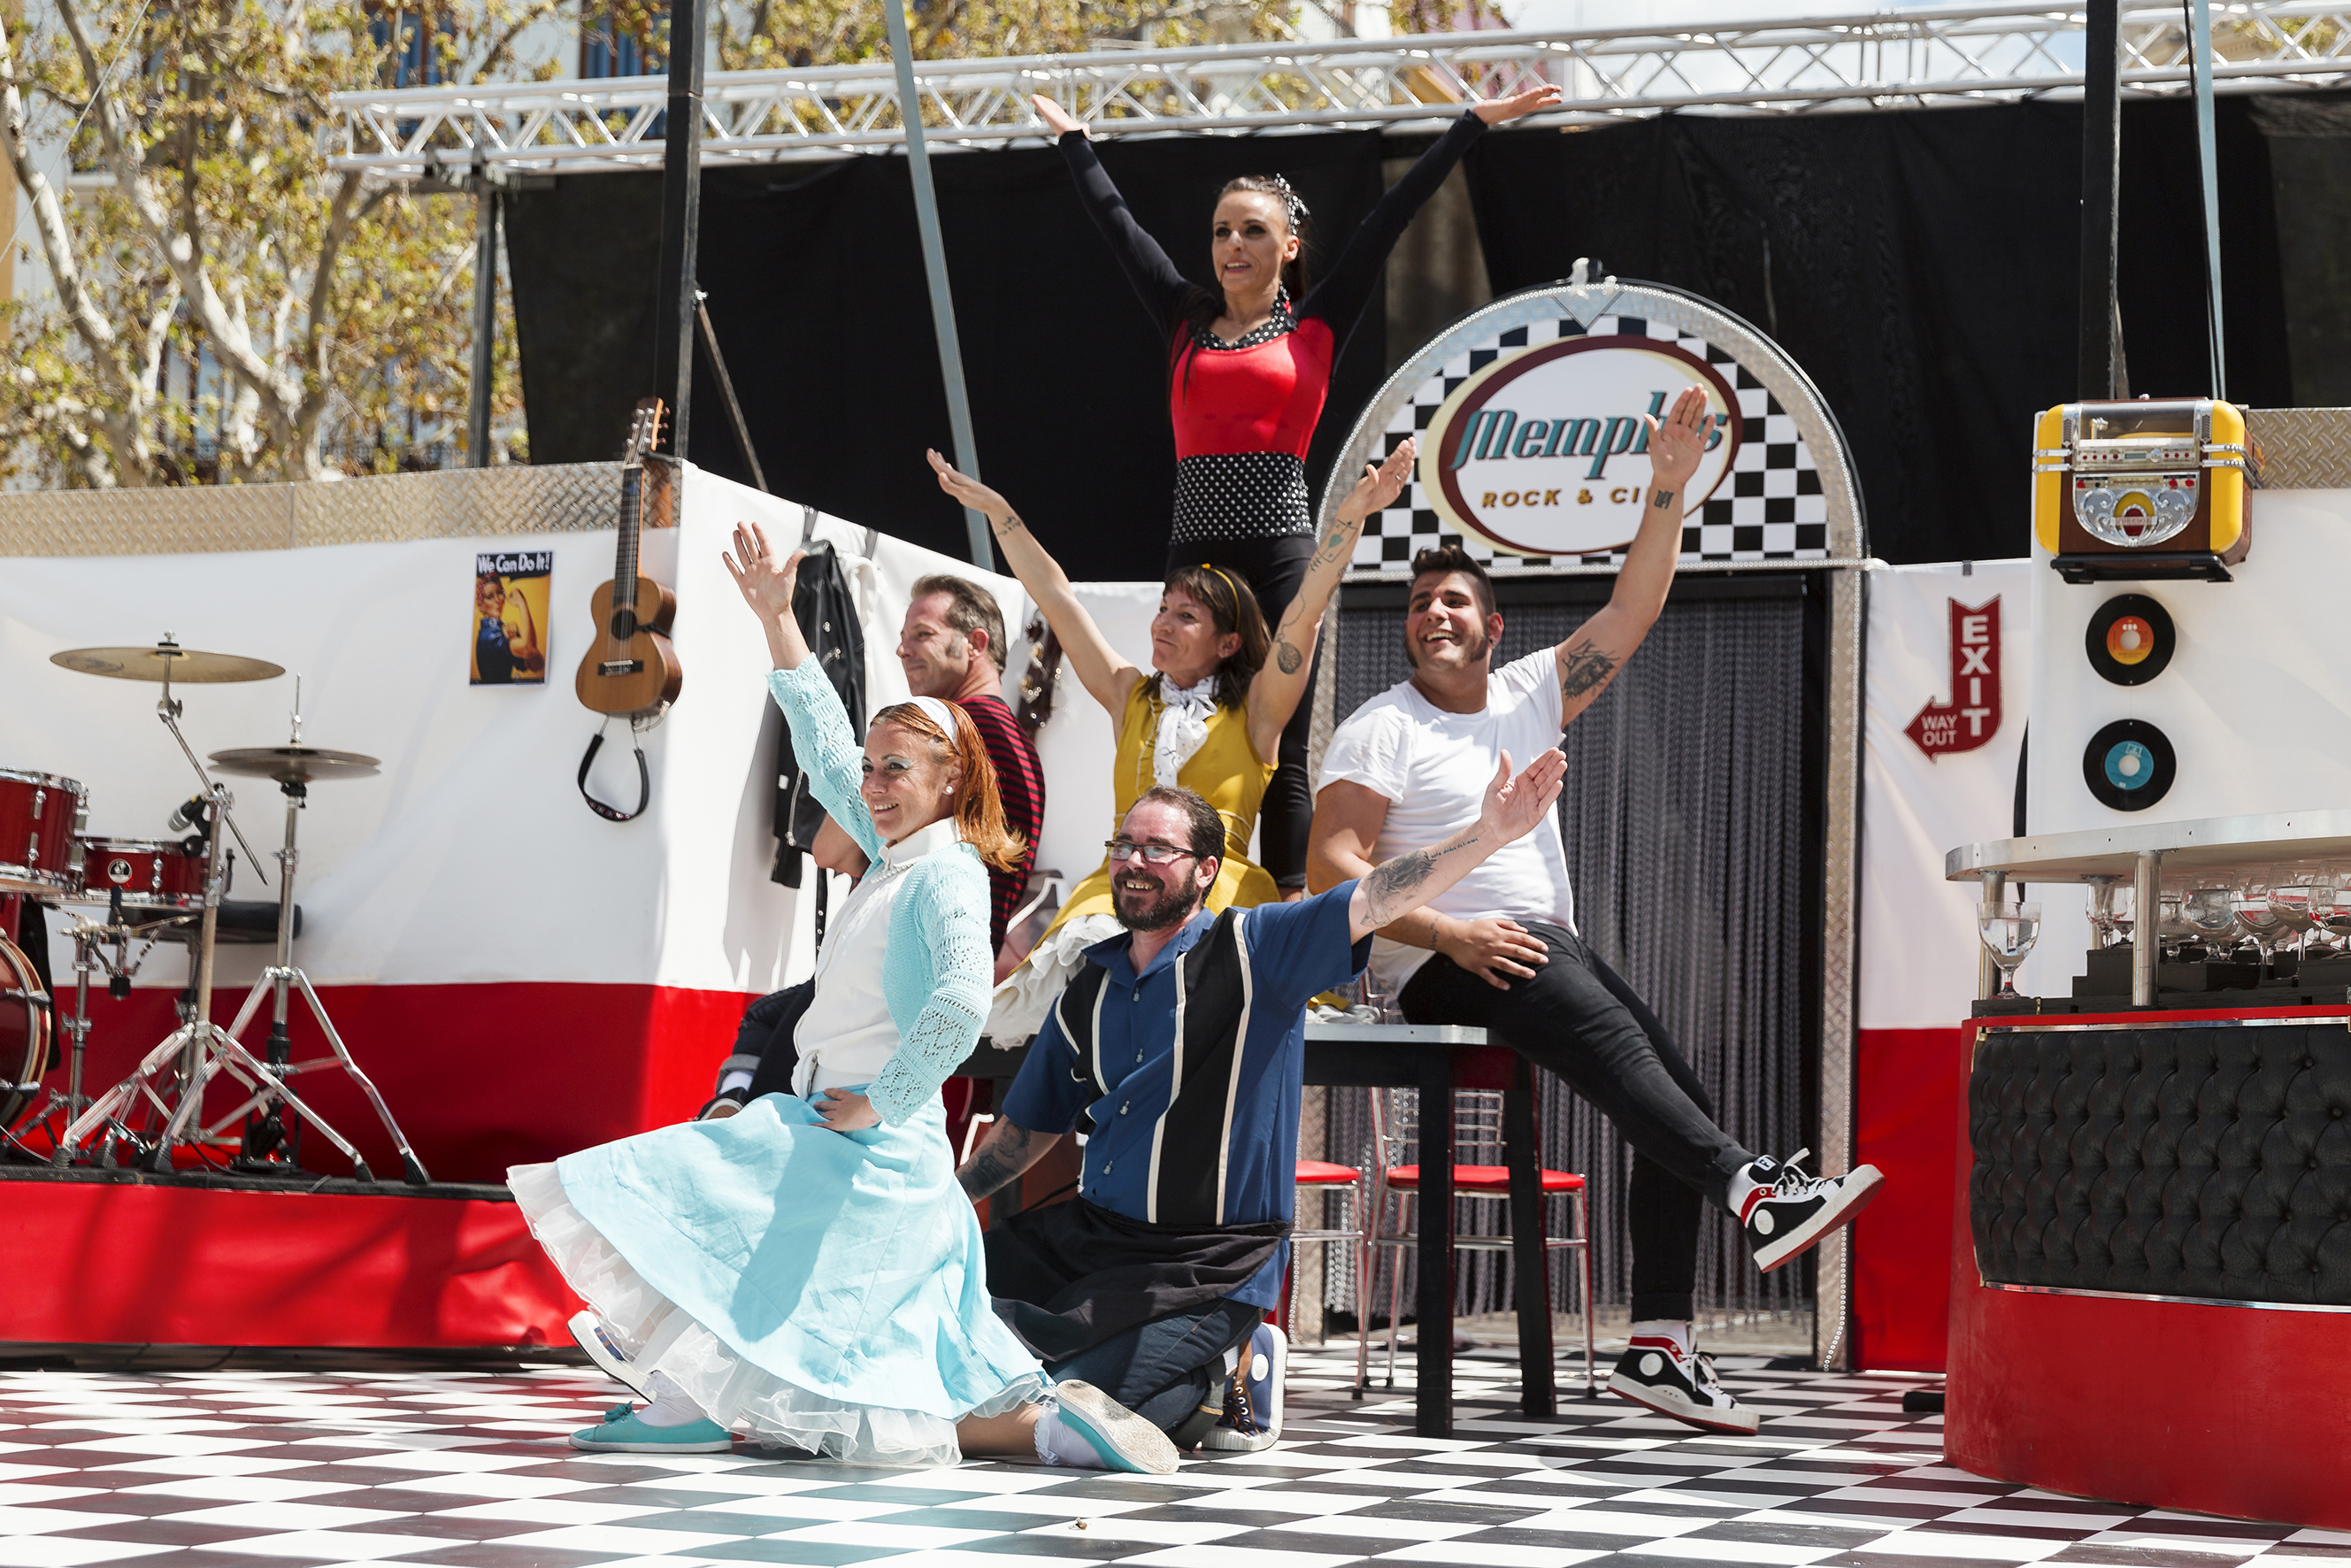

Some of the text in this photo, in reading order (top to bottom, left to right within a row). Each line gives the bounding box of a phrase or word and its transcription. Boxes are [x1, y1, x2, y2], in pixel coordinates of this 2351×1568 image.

[1448, 391, 1728, 480] Memphs
[1481, 488, 1562, 509] ROCK
[1577, 488, 1594, 505] &
[1610, 487, 1648, 505] CI
[478, 551, 550, 573] We Can Do It!
[1959, 614, 1992, 737] EXIT
[1921, 714, 1958, 731] WAY
[1922, 729, 1957, 747] OUT
